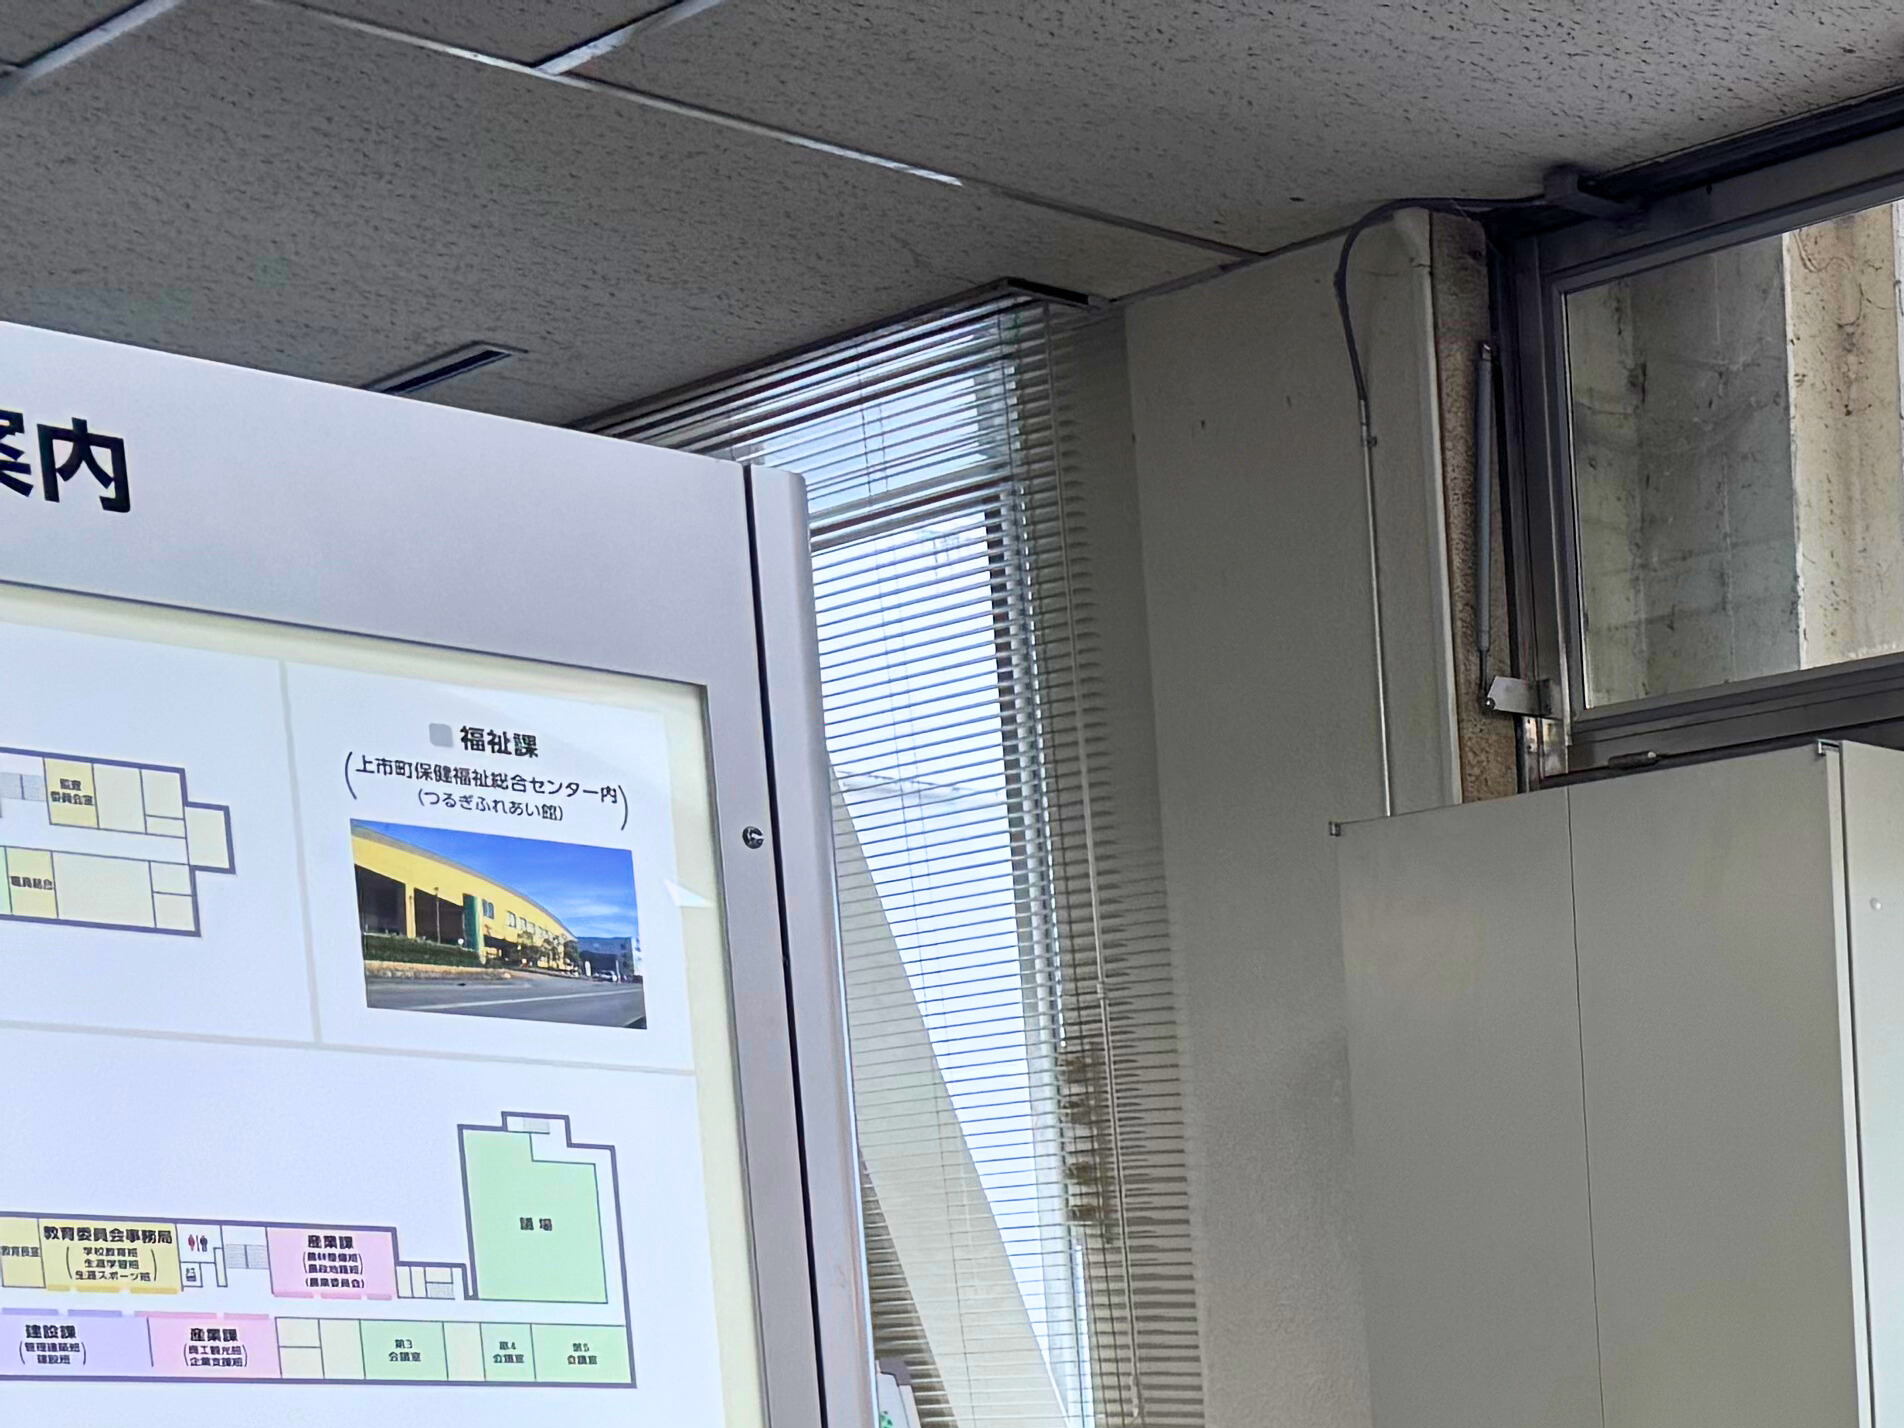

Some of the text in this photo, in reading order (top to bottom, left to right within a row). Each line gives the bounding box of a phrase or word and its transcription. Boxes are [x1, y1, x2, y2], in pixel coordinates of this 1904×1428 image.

[459, 725, 539, 759] 福祉課
[43, 1225, 173, 1245] 教育委員会事務局
